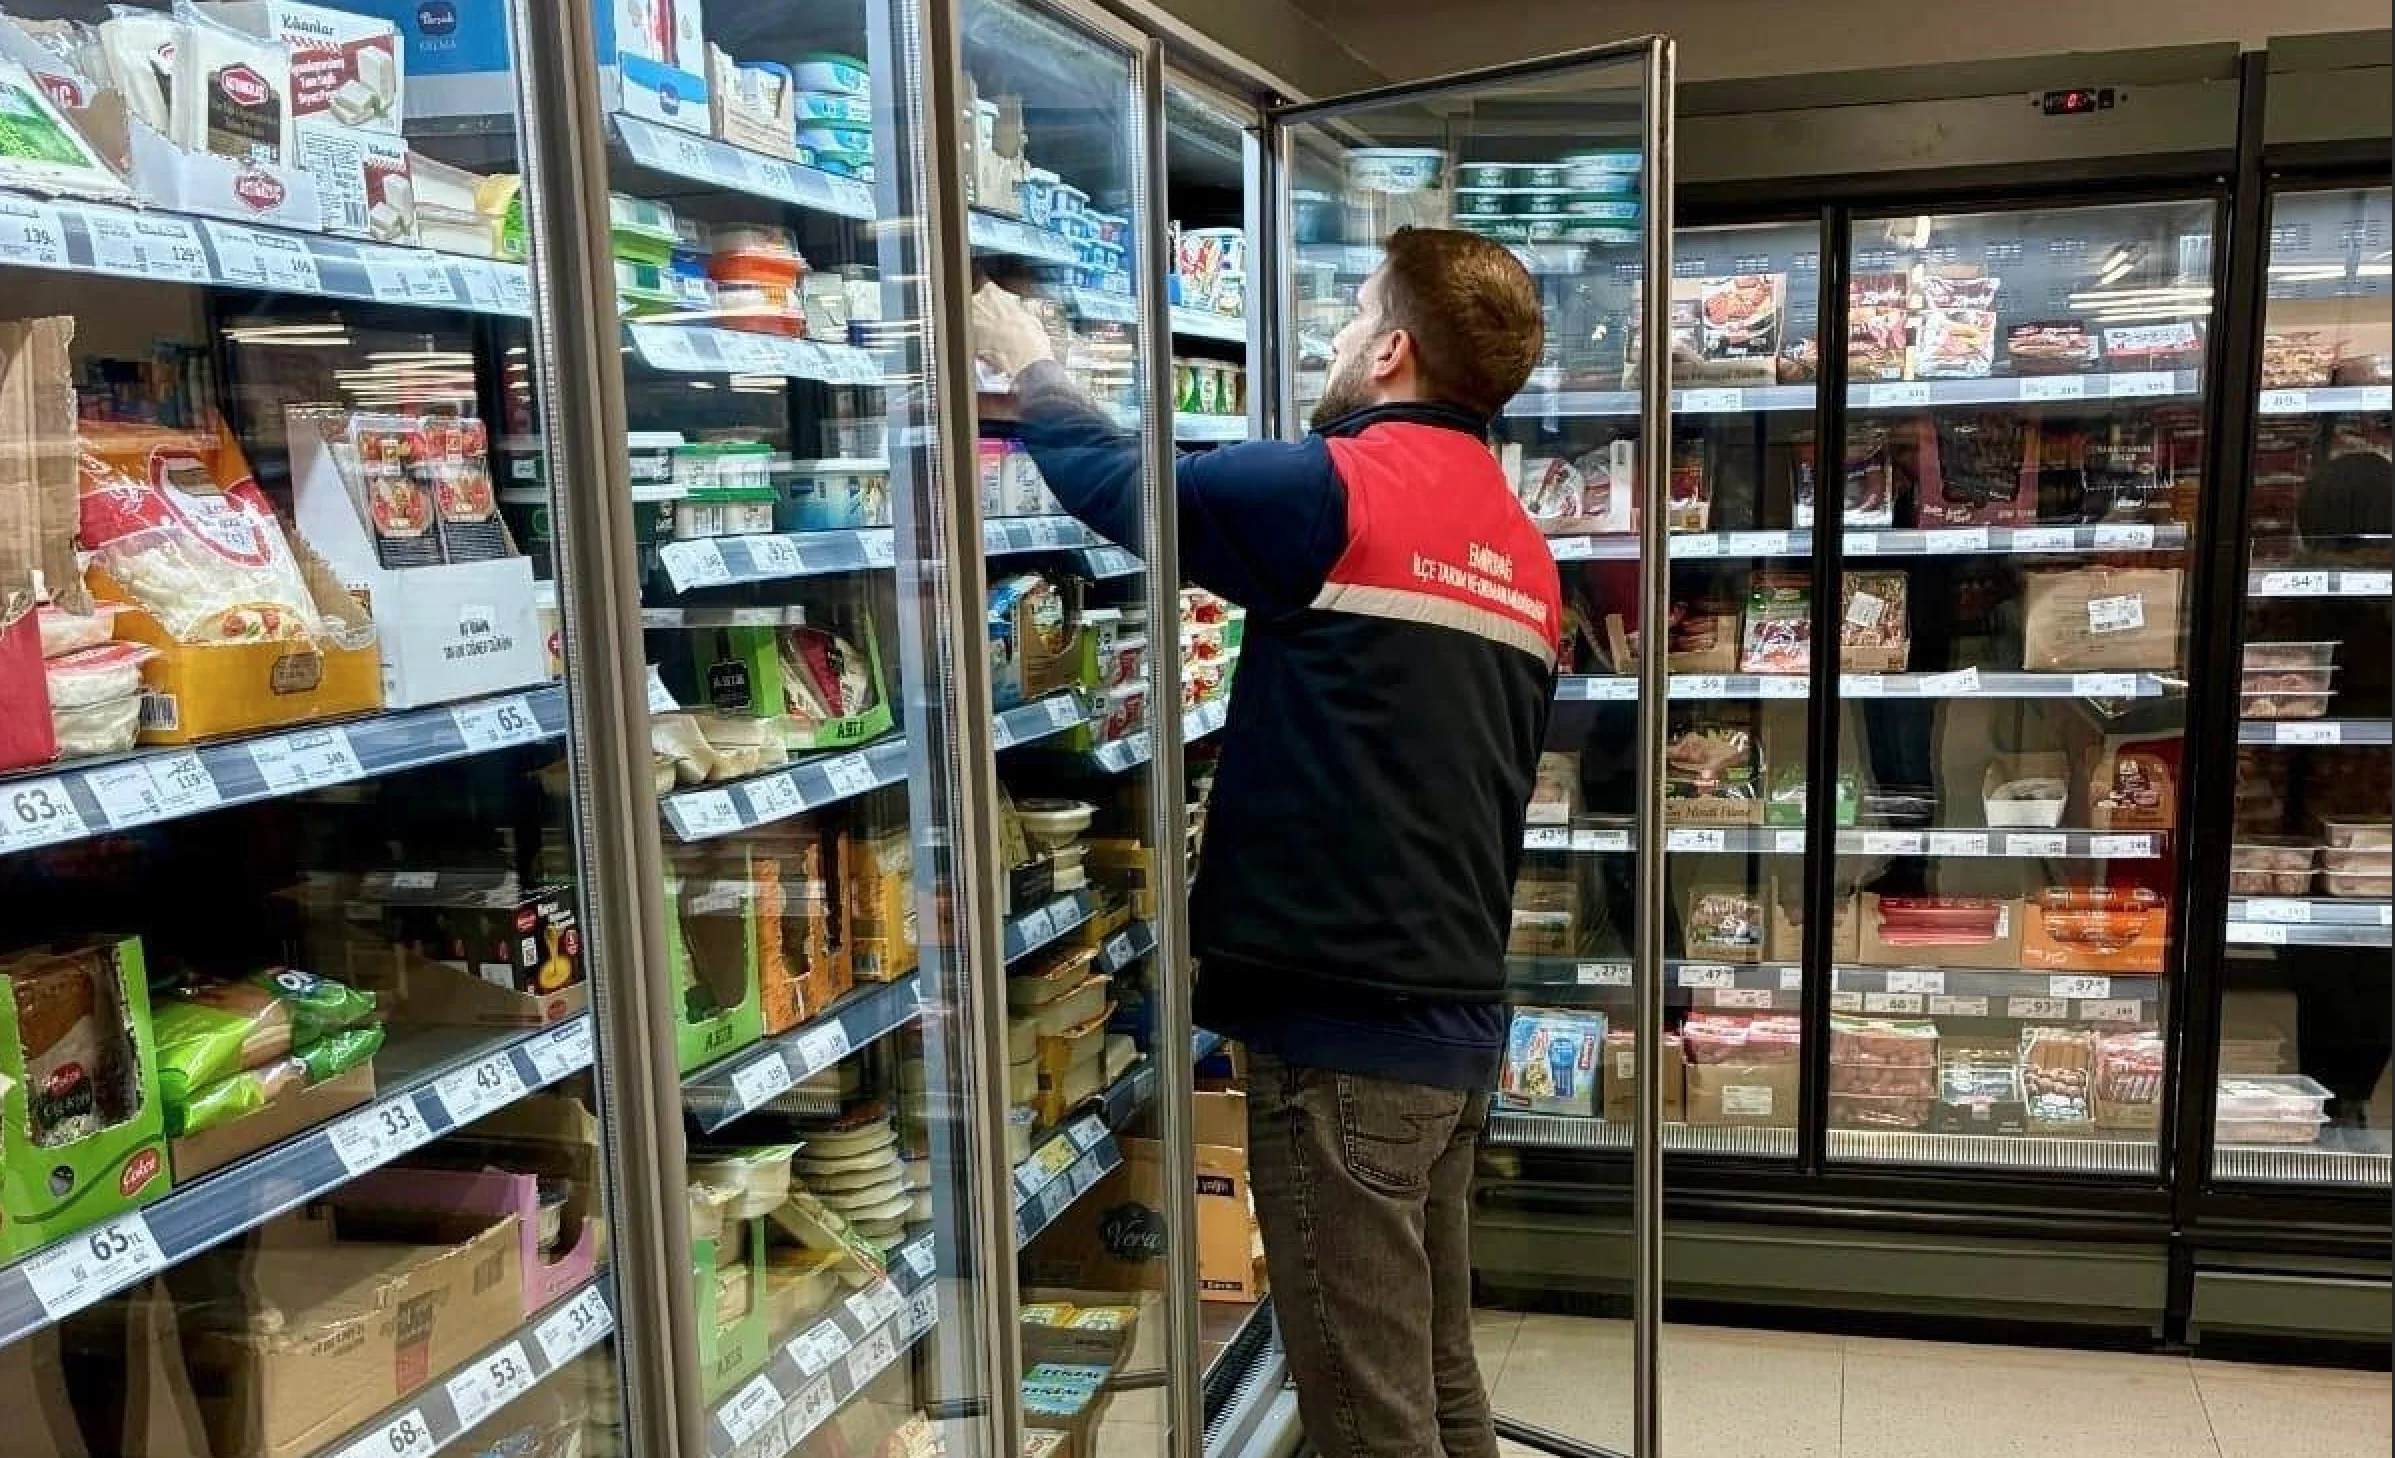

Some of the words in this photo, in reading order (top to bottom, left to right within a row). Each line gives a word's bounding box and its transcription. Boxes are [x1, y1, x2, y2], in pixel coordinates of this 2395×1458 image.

[497, 705, 524, 732] 65
[13, 788, 57, 825] 63
[476, 1062, 501, 1090] 43
[379, 1104, 410, 1136] 33
[90, 1224, 129, 1262] 65
[489, 1356, 517, 1389] 53
[388, 1419, 417, 1454] 68
